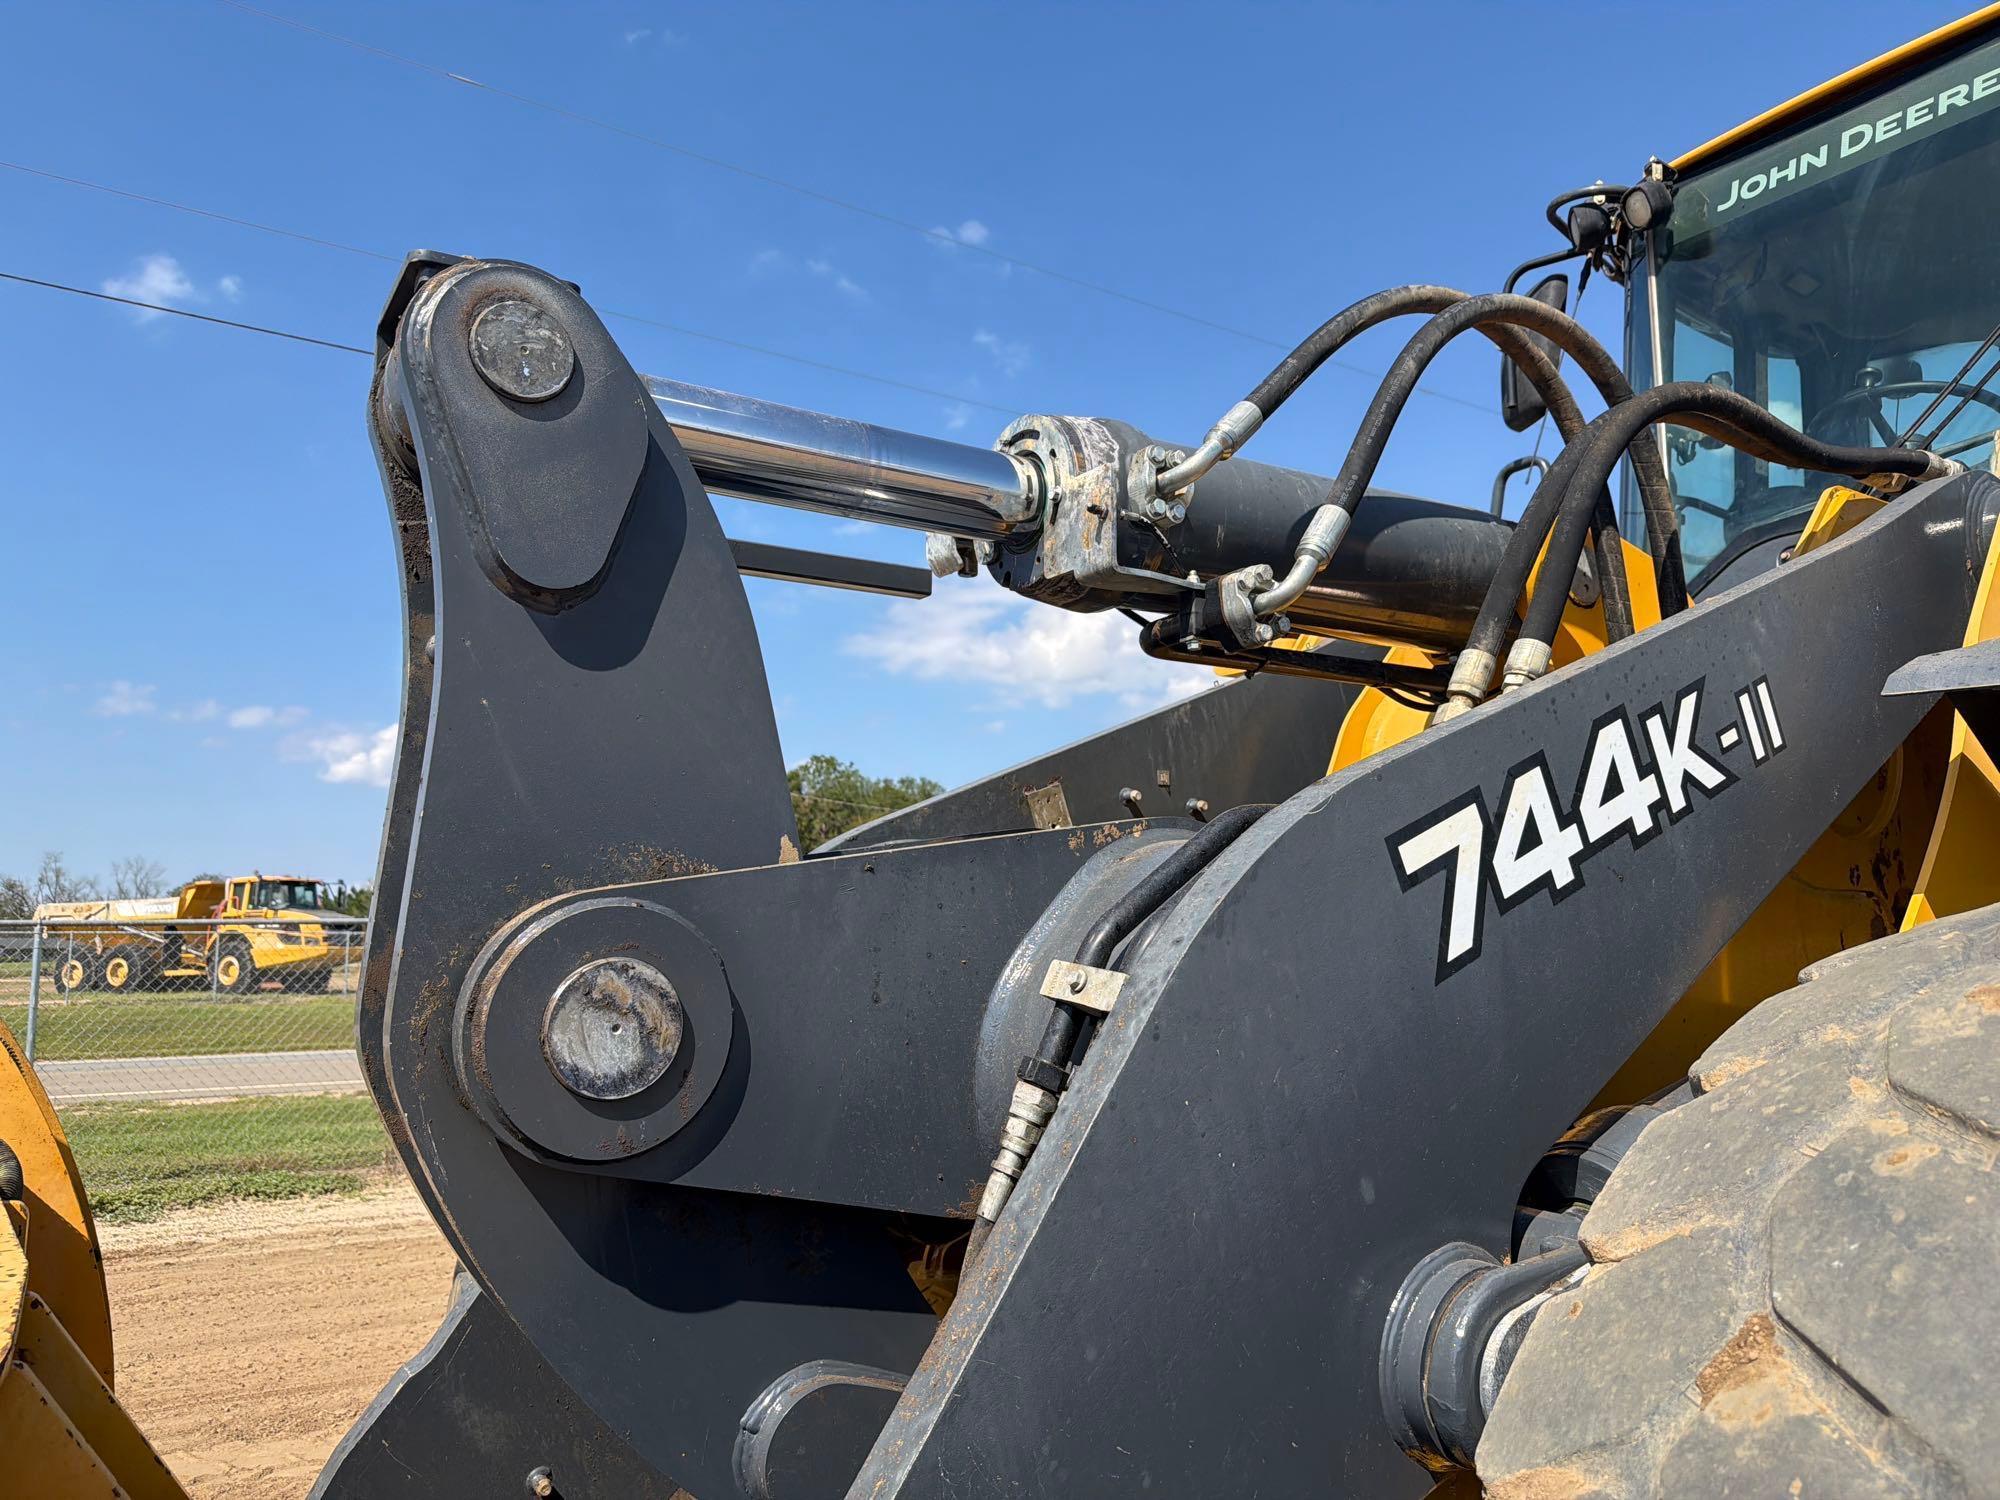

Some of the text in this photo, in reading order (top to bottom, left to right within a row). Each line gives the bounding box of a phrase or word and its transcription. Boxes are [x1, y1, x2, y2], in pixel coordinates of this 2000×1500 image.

[1716, 66, 2000, 212] JOHN DEERE
[1393, 679, 1785, 966] 744K-II
[139, 904, 173, 914] LVO
